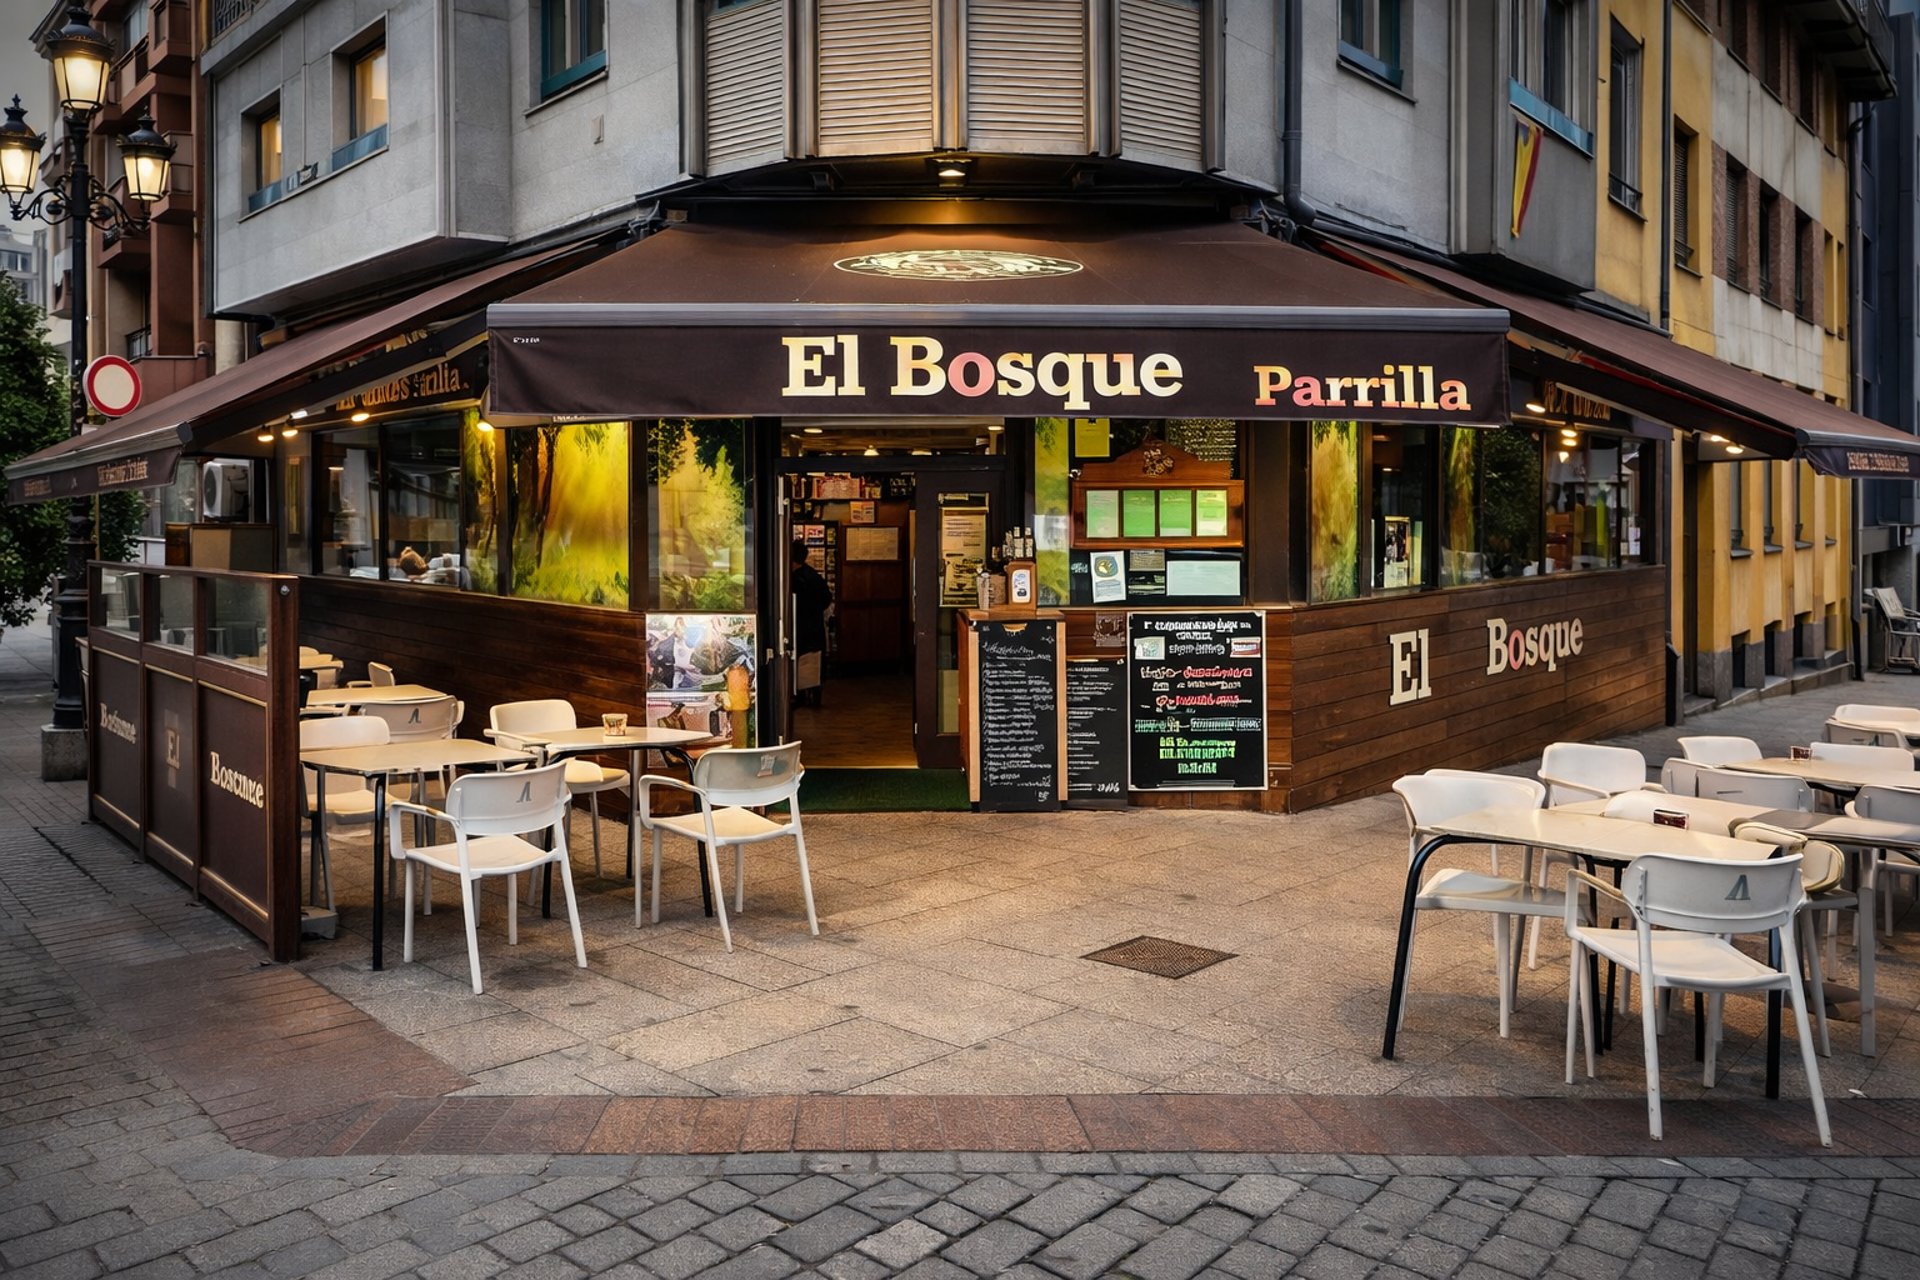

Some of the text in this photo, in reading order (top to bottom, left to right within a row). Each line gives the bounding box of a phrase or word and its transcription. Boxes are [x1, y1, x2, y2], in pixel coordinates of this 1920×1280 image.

[781, 334, 1184, 411] El Bosque
[1254, 364, 1472, 411] Parrilla
[1389, 617, 1584, 706] El Bosque
